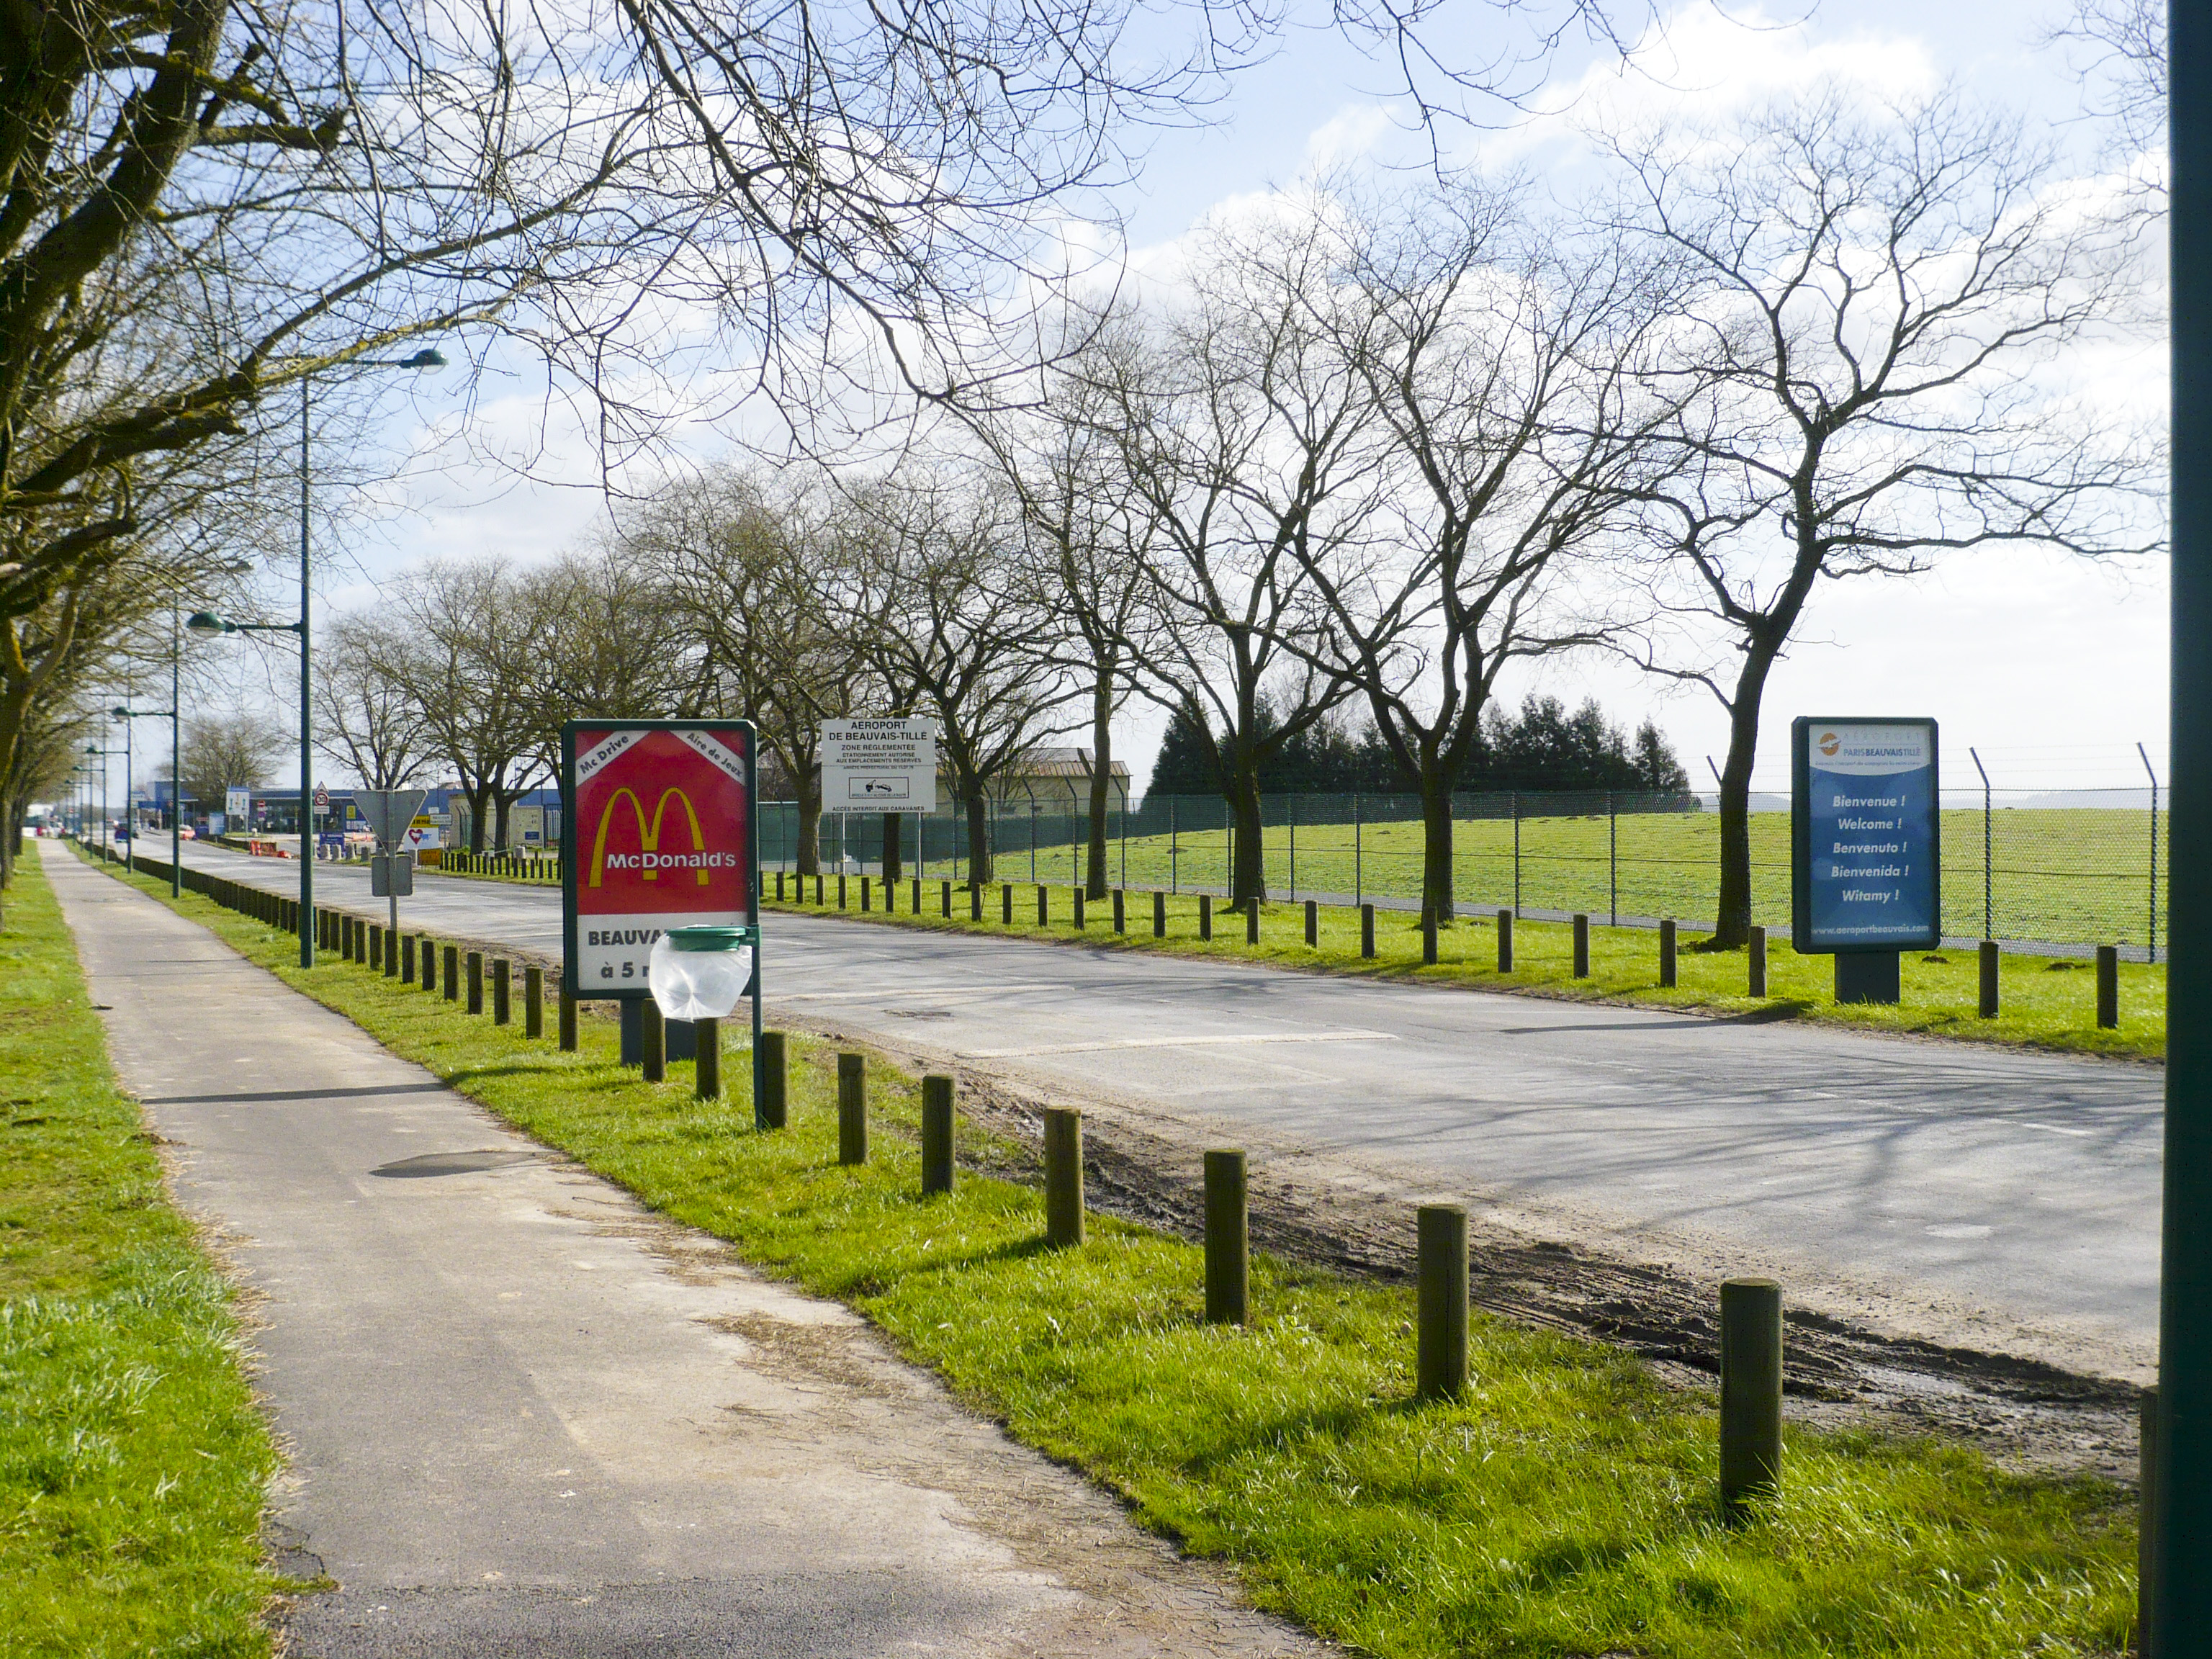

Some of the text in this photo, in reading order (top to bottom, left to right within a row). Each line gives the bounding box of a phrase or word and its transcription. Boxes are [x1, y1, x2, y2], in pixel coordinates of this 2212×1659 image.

[851, 721, 907, 729] AEROPORT
[845, 730, 927, 740] BEAUVAIS-TILLÉ
[579, 735, 629, 775] Mc Drive
[686, 732, 743, 778] Aire de Jeux
[1833, 795, 1907, 807] Bienvenue !
[1838, 817, 1902, 830] Welcome !
[1833, 841, 1907, 853] Benvenuto !
[607, 852, 737, 868] McDonald's
[1831, 865, 1910, 878] Bienvenida !
[1842, 889, 1899, 904] Witamy !
[1811, 923, 1929, 936] www.aeroportbeauvais.com
[588, 929, 668, 946] BEAUVA
[600, 961, 614, 979] à
[621, 961, 634, 979] 5
